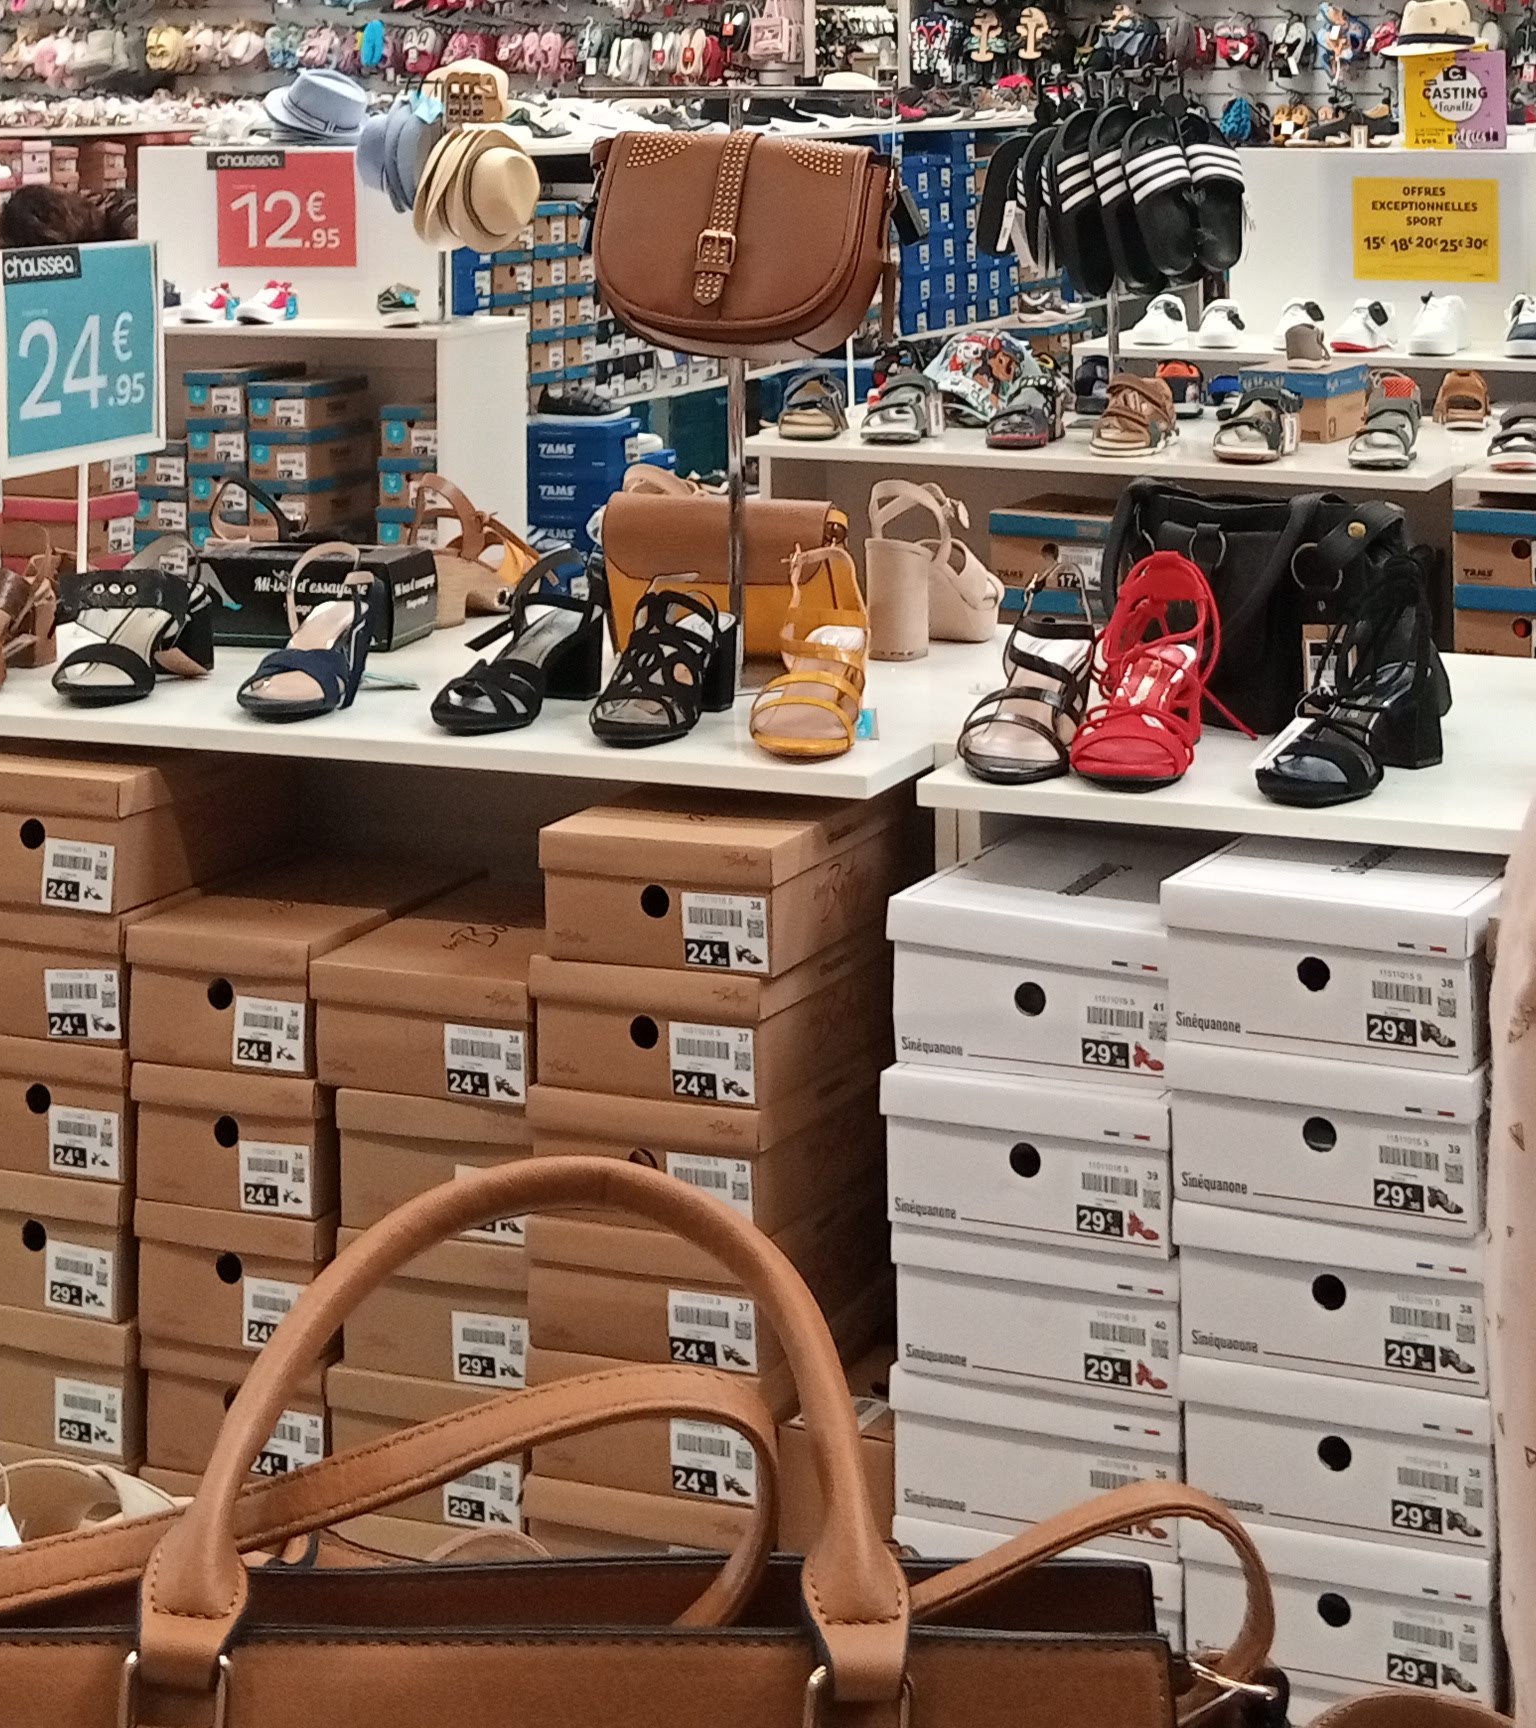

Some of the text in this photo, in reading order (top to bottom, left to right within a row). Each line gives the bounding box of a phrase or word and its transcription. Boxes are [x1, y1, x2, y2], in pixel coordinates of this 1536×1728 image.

[1422, 86, 1488, 100] CASTING
[1402, 185, 1446, 197] OFFRES
[1371, 200, 1478, 212] EXCEPTIONNELLES
[1405, 215, 1443, 227] SPORT
[1440, 977, 1454, 989] 38
[1175, 1010, 1242, 1034] Sinéquanone
[737, 1032, 750, 1043] 37
[901, 1036, 964, 1056] Sinéquanone
[1447, 1144, 1462, 1155] 39
[1181, 1171, 1248, 1195] Sinéquanone
